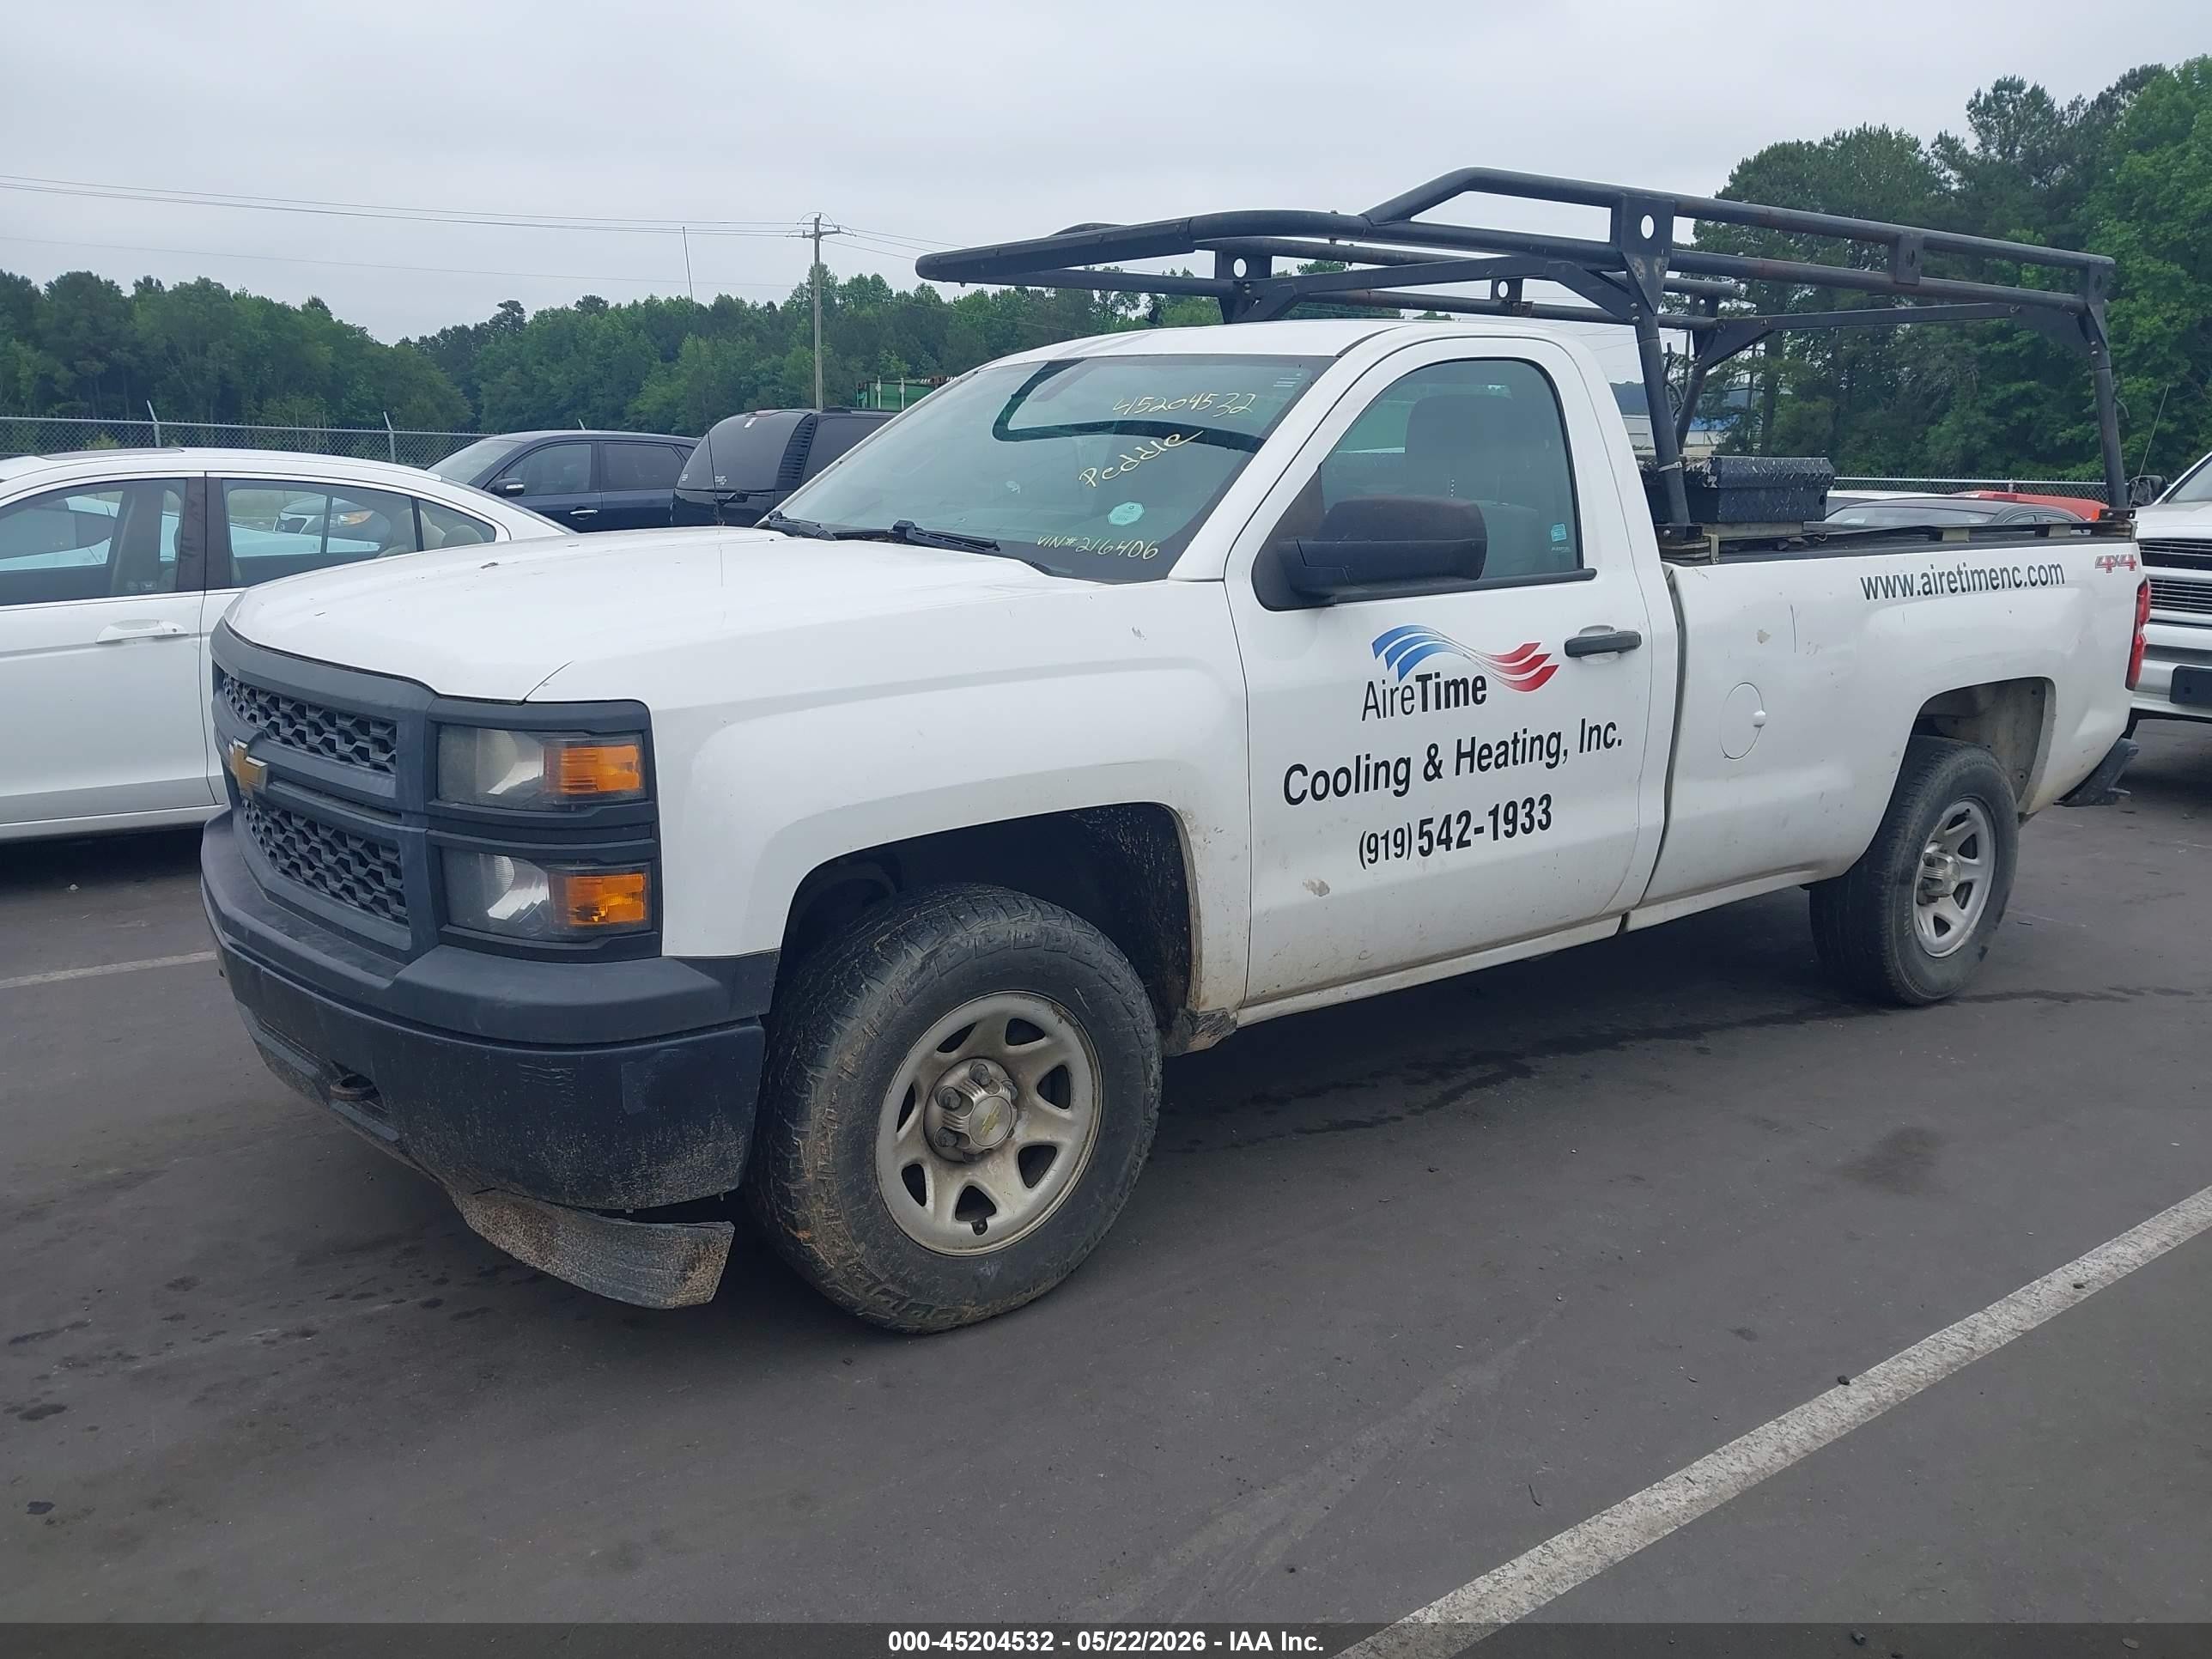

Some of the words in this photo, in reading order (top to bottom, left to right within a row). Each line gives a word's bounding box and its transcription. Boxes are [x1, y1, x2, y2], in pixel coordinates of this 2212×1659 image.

[1113, 392, 1256, 417] 45204532
[1079, 429, 1204, 488] Peddle
[1860, 562, 2065, 600] www.airetimenc.com
[1362, 672, 1487, 721] AireTime
[1283, 753, 1412, 805] Cooling
[1422, 743, 1443, 782] &
[1455, 729, 1569, 776] Heating,
[1578, 718, 1623, 754] Inc.
[1358, 822, 1413, 869] (919)
[1418, 793, 1553, 857] 542-1933
